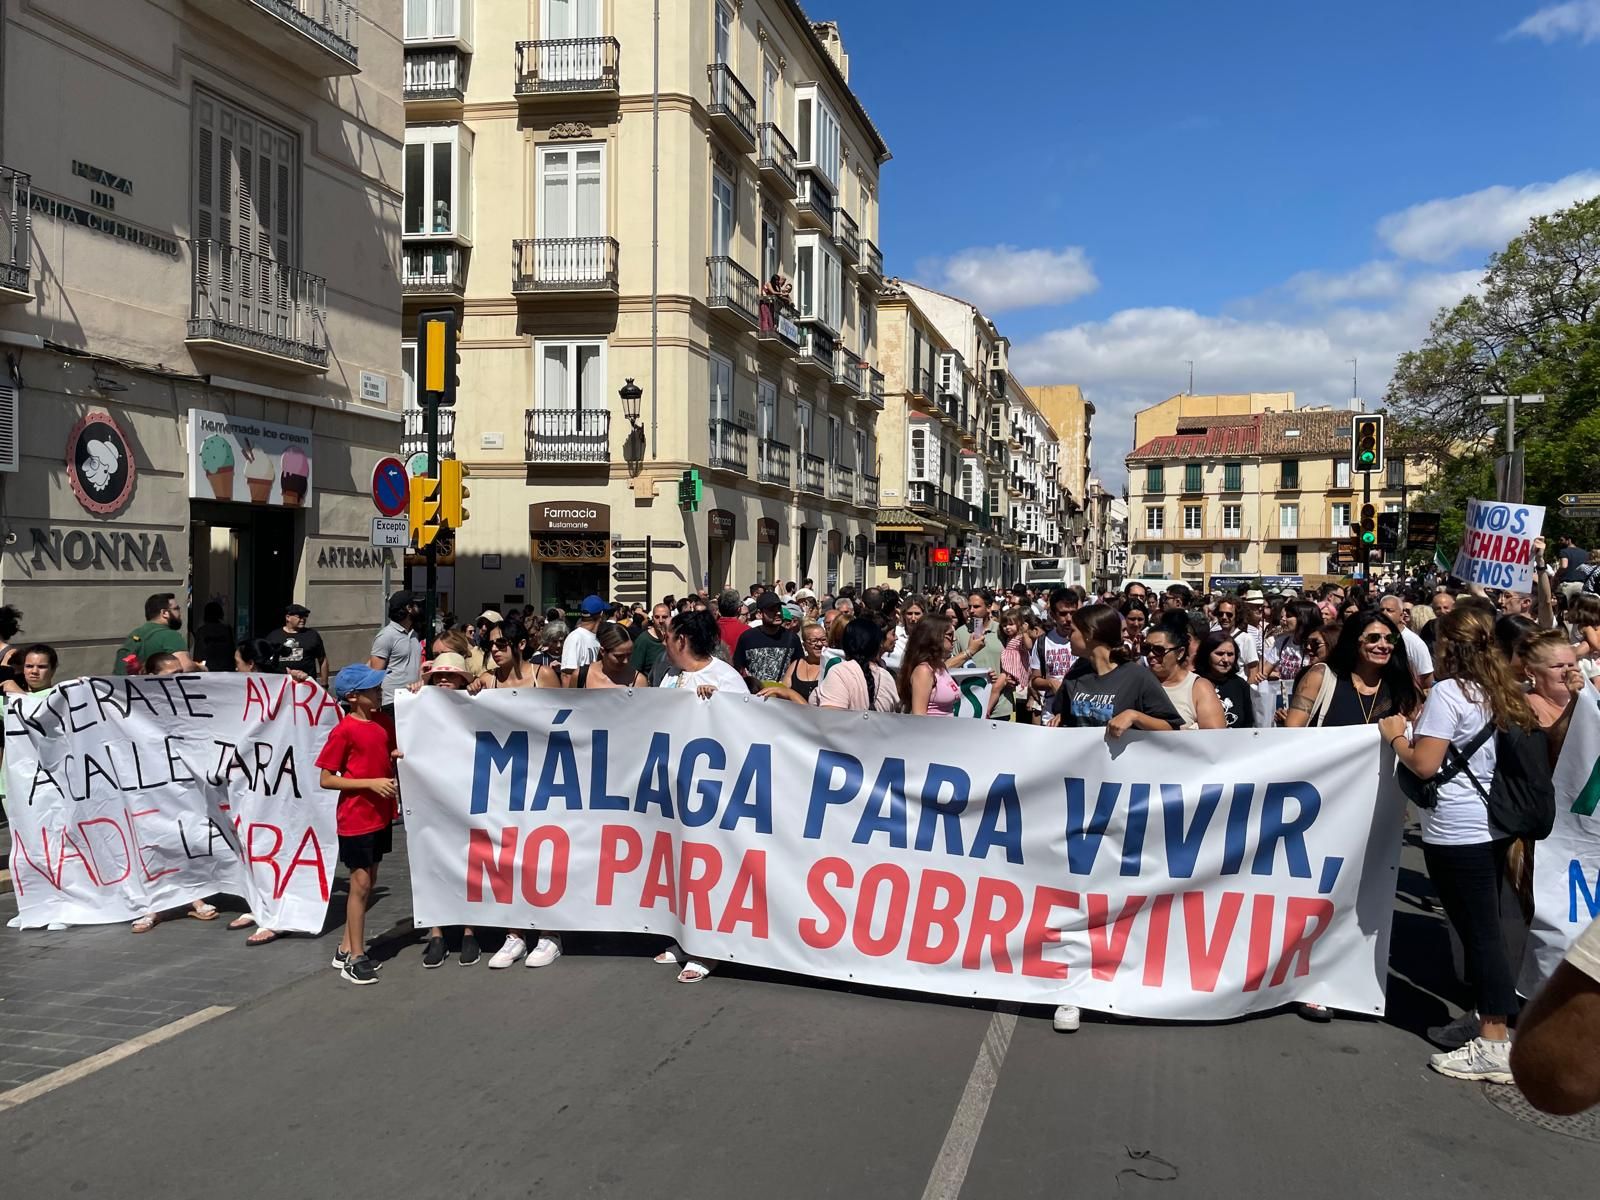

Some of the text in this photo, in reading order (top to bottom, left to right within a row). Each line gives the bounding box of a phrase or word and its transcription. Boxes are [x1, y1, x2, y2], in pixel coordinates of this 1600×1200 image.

[201, 417, 309, 445] homemade ice cream
[377, 521, 406, 532] Excepto
[544, 508, 597, 519] Farmacia
[549, 521, 589, 529] Bustamante
[30, 528, 174, 572] NONNA
[386, 535, 399, 544] taxi
[243, 677, 345, 727] AVRA
[65, 736, 196, 802] CALLE
[207, 740, 302, 799] JARA
[470, 709, 1345, 894] MÁLAGA PARA VIVIR,
[466, 824, 1335, 993] NO PARA SOBREVIVIR
